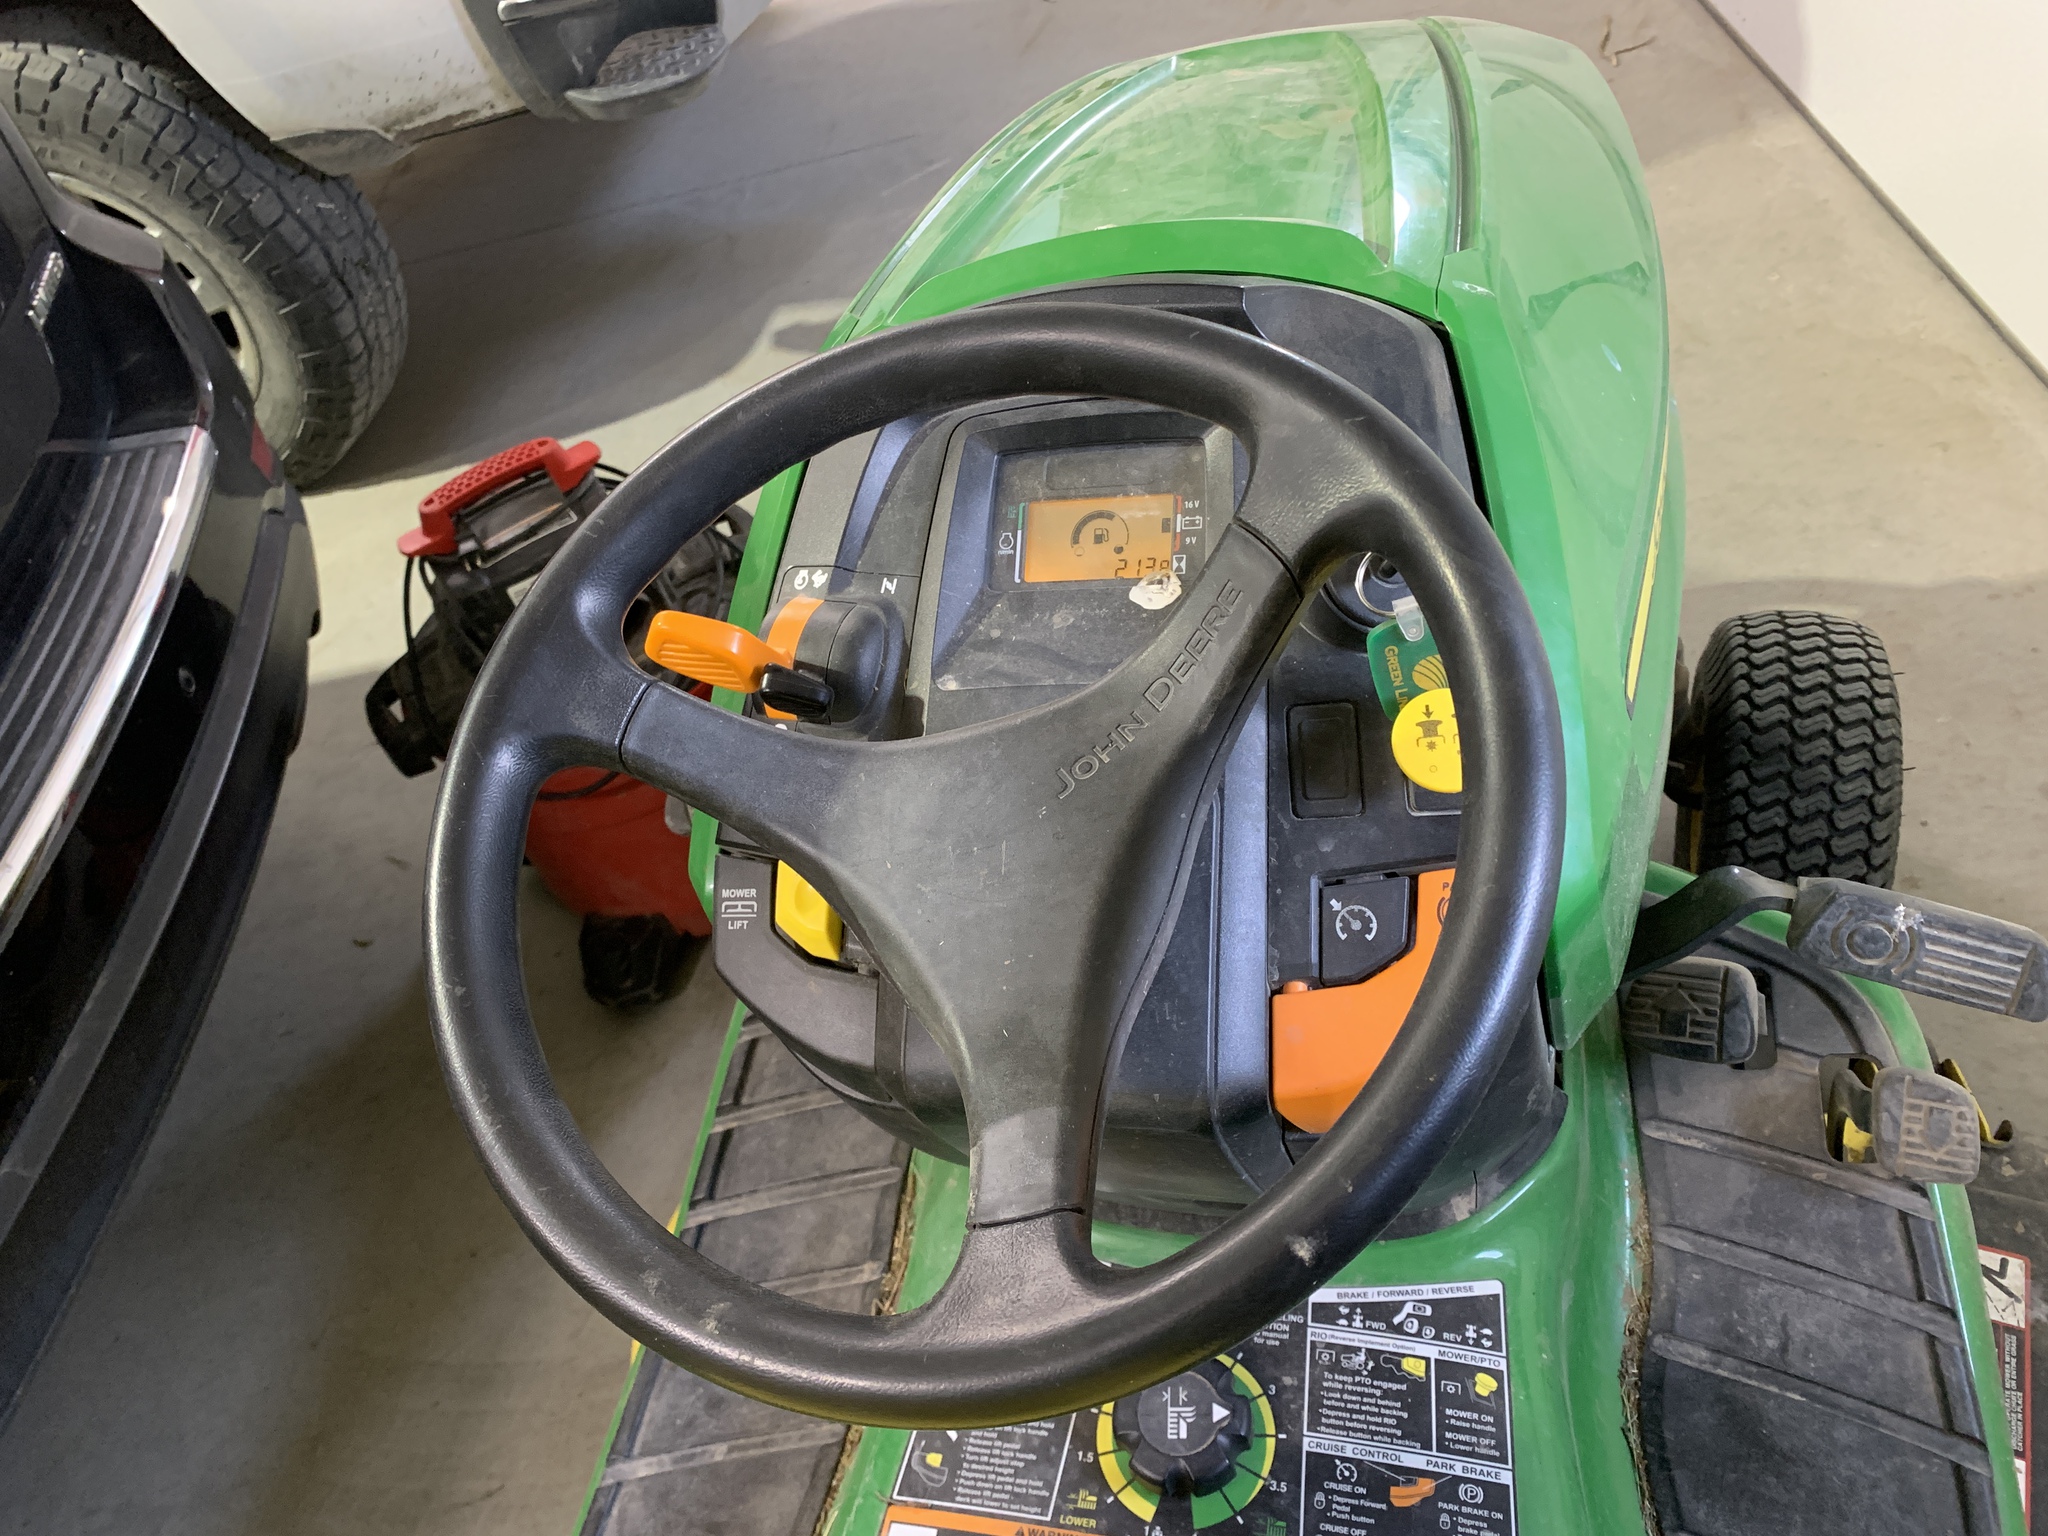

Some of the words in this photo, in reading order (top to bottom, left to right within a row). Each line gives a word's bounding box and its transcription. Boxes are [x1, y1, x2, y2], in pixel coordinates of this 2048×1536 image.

[1184, 500, 1194, 508] 16
[1194, 500, 1200, 508] V
[1385, 645, 1404, 687] GREEN
[1056, 710, 1149, 800] JOHN
[1143, 579, 1245, 713] DEERE
[722, 888, 757, 898] MOWER
[728, 920, 749, 930] LIFT
[1337, 1291, 1369, 1300] BRAKE
[1377, 1289, 1424, 1299] FORWARD
[1432, 1285, 1475, 1295] REVERSE
[1365, 1321, 1387, 1331] FWD
[1253, 1336, 1265, 1344] for
[1266, 1339, 1280, 1347] use
[1262, 1331, 1289, 1339] manual
[1310, 1331, 1328, 1340] RIO
[1328, 1334, 1356, 1343] (Reverse
[1357, 1337, 1391, 1348] Implement
[1392, 1340, 1416, 1352] Option)
[1443, 1332, 1462, 1343] REV
[1438, 1350, 1501, 1368] MOWER/PTO
[1324, 1371, 1333, 1379] To
[1335, 1374, 1353, 1383] keep
[1354, 1376, 1372, 1385] PTO
[1373, 1379, 1407, 1391] engaged
[2011, 1380, 2017, 1390] OR
[1268, 1385, 1276, 1395] 3
[1322, 1381, 1343, 1390] while
[1345, 1384, 1384, 1396] reversing:
[1324, 1391, 1341, 1399] Look
[1342, 1392, 1361, 1401] down
[1363, 1395, 1376, 1404] and
[1377, 1397, 1401, 1408] behind
[1323, 1399, 1345, 1408] before
[1347, 1402, 1360, 1410] and
[1361, 1403, 1379, 1413] while
[1380, 1406, 1408, 1419] backing
[1445, 1408, 1479, 1420] MOWER
[1481, 1414, 1494, 1423] ON
[1322, 1408, 1350, 1418] Depress
[1352, 1411, 1365, 1420] and
[1366, 1413, 1382, 1423] hold
[1383, 1417, 1397, 1426] RIO
[1321, 1417, 1344, 1426] button
[1345, 1420, 1367, 1430] before
[1369, 1424, 1402, 1436] reversing
[1450, 1419, 1471, 1428] Raise
[1472, 1423, 1496, 1433] handle
[1321, 1426, 1347, 1436] Release
[1349, 1430, 1372, 1440] button
[1373, 1434, 1392, 1443] while
[1393, 1437, 1421, 1449] backing
[1445, 1431, 1478, 1444] MOWER
[1480, 1438, 1496, 1447] OFF
[1308, 1440, 1347, 1454] CRUISE
[1352, 1446, 1404, 1463] CONTROL
[1450, 1442, 1473, 1452] Lower
[1077, 1451, 1095, 1463] 1.5
[1426, 1459, 1457, 1473] PARK
[1461, 1465, 1502, 1481] BRAKE
[1269, 1480, 1288, 1493] 3.5
[1324, 1481, 1353, 1492] CRUISE
[1354, 1486, 1367, 1495] ON
[1332, 1494, 1359, 1505] Depress
[1360, 1499, 1387, 1510] Forward
[1332, 1503, 1351, 1512] Pedal
[1331, 1511, 1350, 1520] Push
[1351, 1514, 1375, 1524] button
[1438, 1501, 1460, 1512] PARK
[1461, 1505, 1490, 1518] BRAKE
[1491, 1511, 1504, 1520] ON
[1060, 1515, 1097, 1529] LOWER
[1457, 1516, 1488, 1528] Depress
[1319, 1523, 1349, 1534] CRUISE
[1350, 1527, 1367, 1536] OFF
[1457, 1525, 1478, 1536] brake
